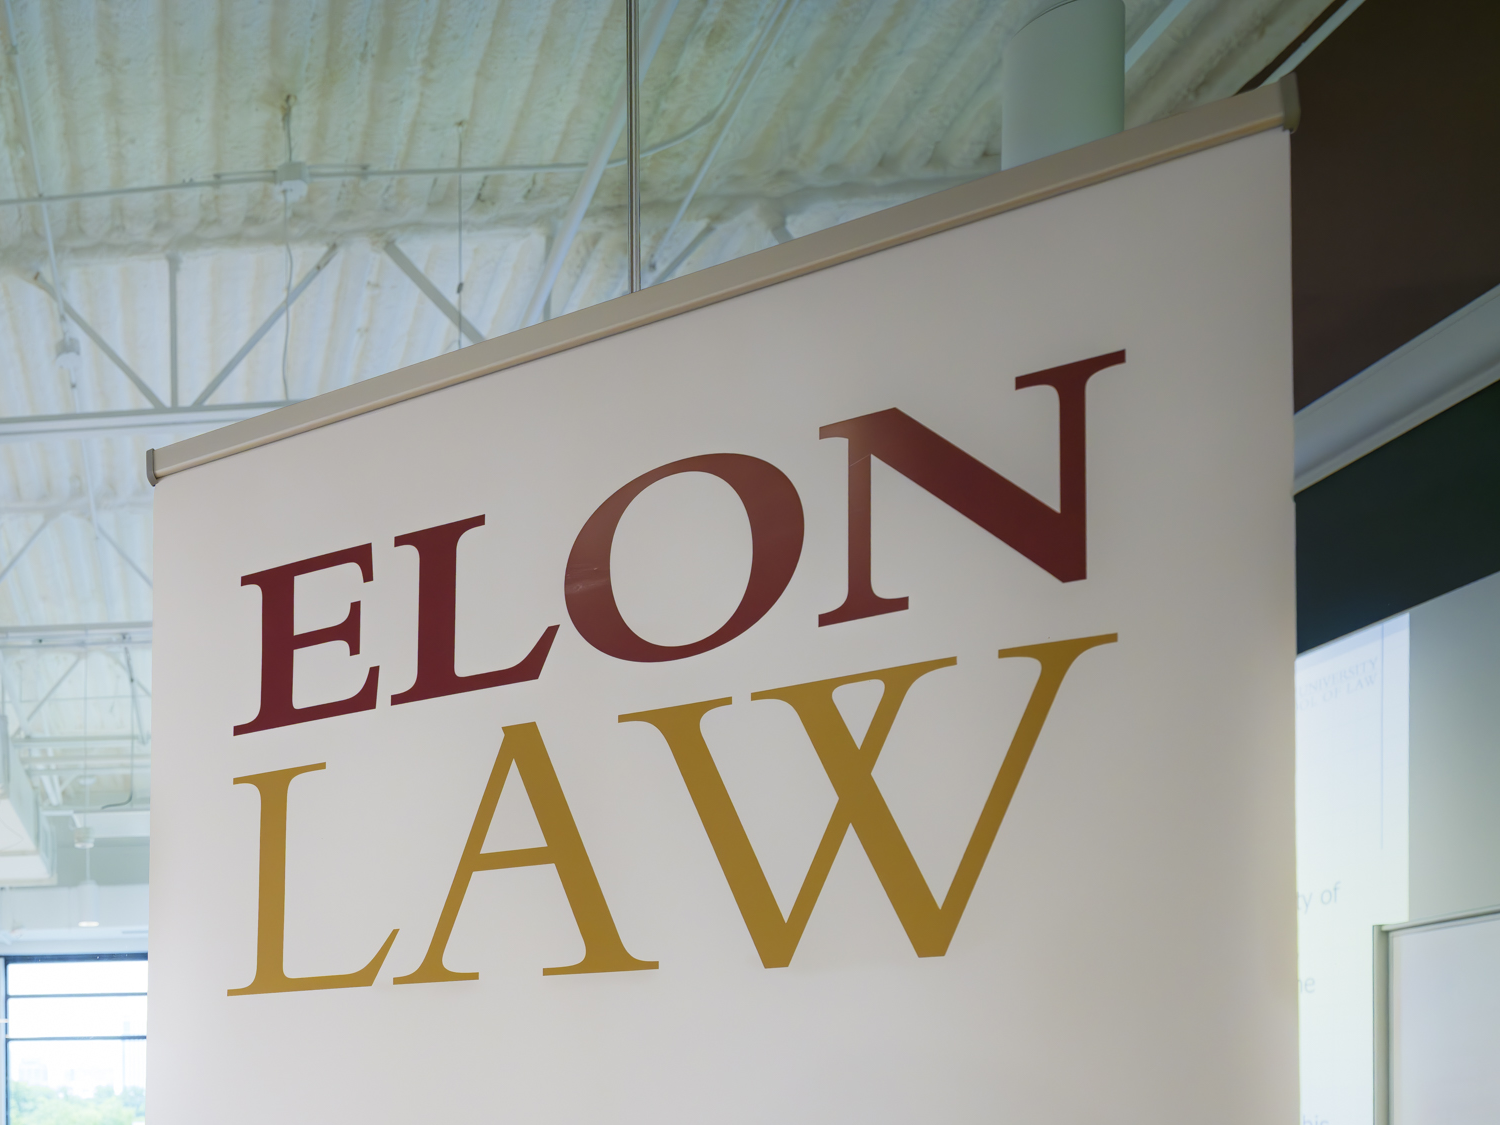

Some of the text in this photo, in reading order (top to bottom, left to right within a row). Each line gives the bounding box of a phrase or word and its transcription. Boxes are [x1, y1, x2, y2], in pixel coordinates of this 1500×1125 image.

[233, 349, 1125, 736] ELON
[1322, 687, 1341, 703] OF
[1346, 672, 1377, 694] LAW
[227, 633, 1118, 998] LAW
[1320, 881, 1341, 905] of
